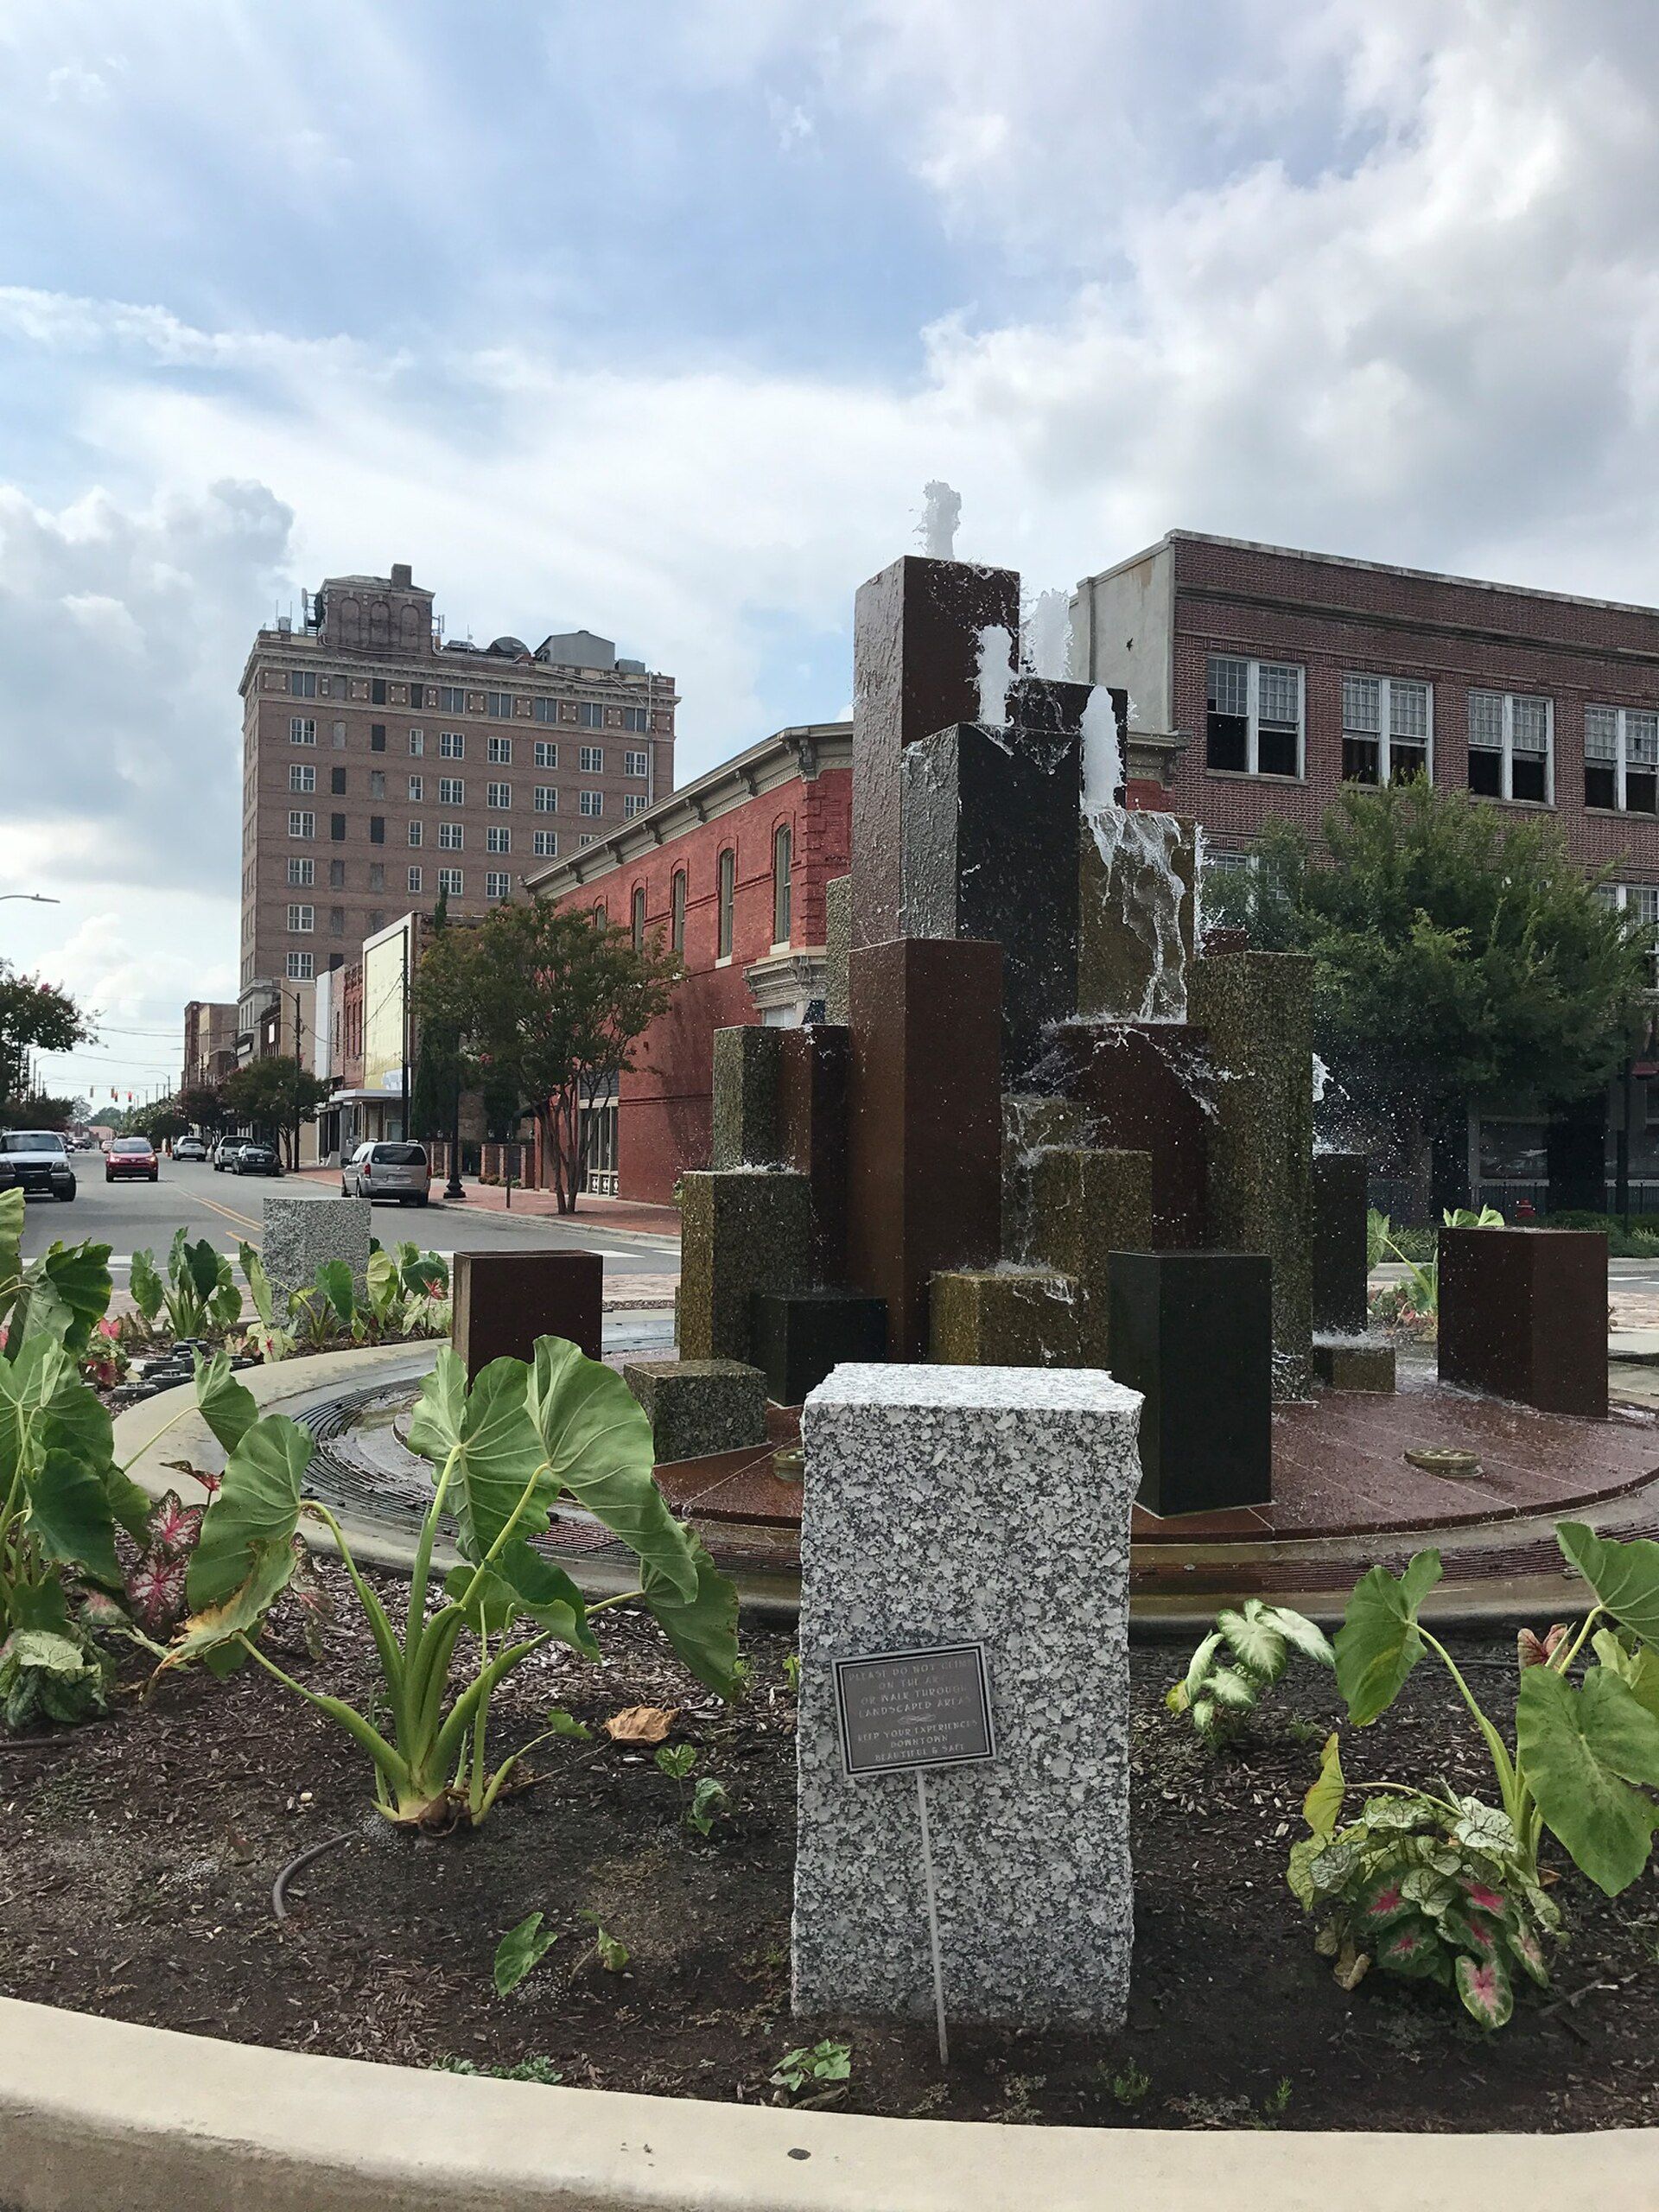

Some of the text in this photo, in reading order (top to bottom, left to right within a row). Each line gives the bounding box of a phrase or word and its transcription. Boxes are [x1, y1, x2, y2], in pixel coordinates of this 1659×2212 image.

[893, 1667, 908, 1676] DO
[913, 1663, 935, 1674] NOT
[879, 1681, 893, 1690] ON
[901, 1678, 919, 1687] THE
[861, 1695, 876, 1705] OR
[881, 1690, 911, 1702] WALK
[858, 1702, 932, 1719] LANDSCAPED
[884, 1728, 912, 1738] YOUR
[890, 1734, 948, 1748] DOWNTOWN
[932, 1745, 938, 1754] &
